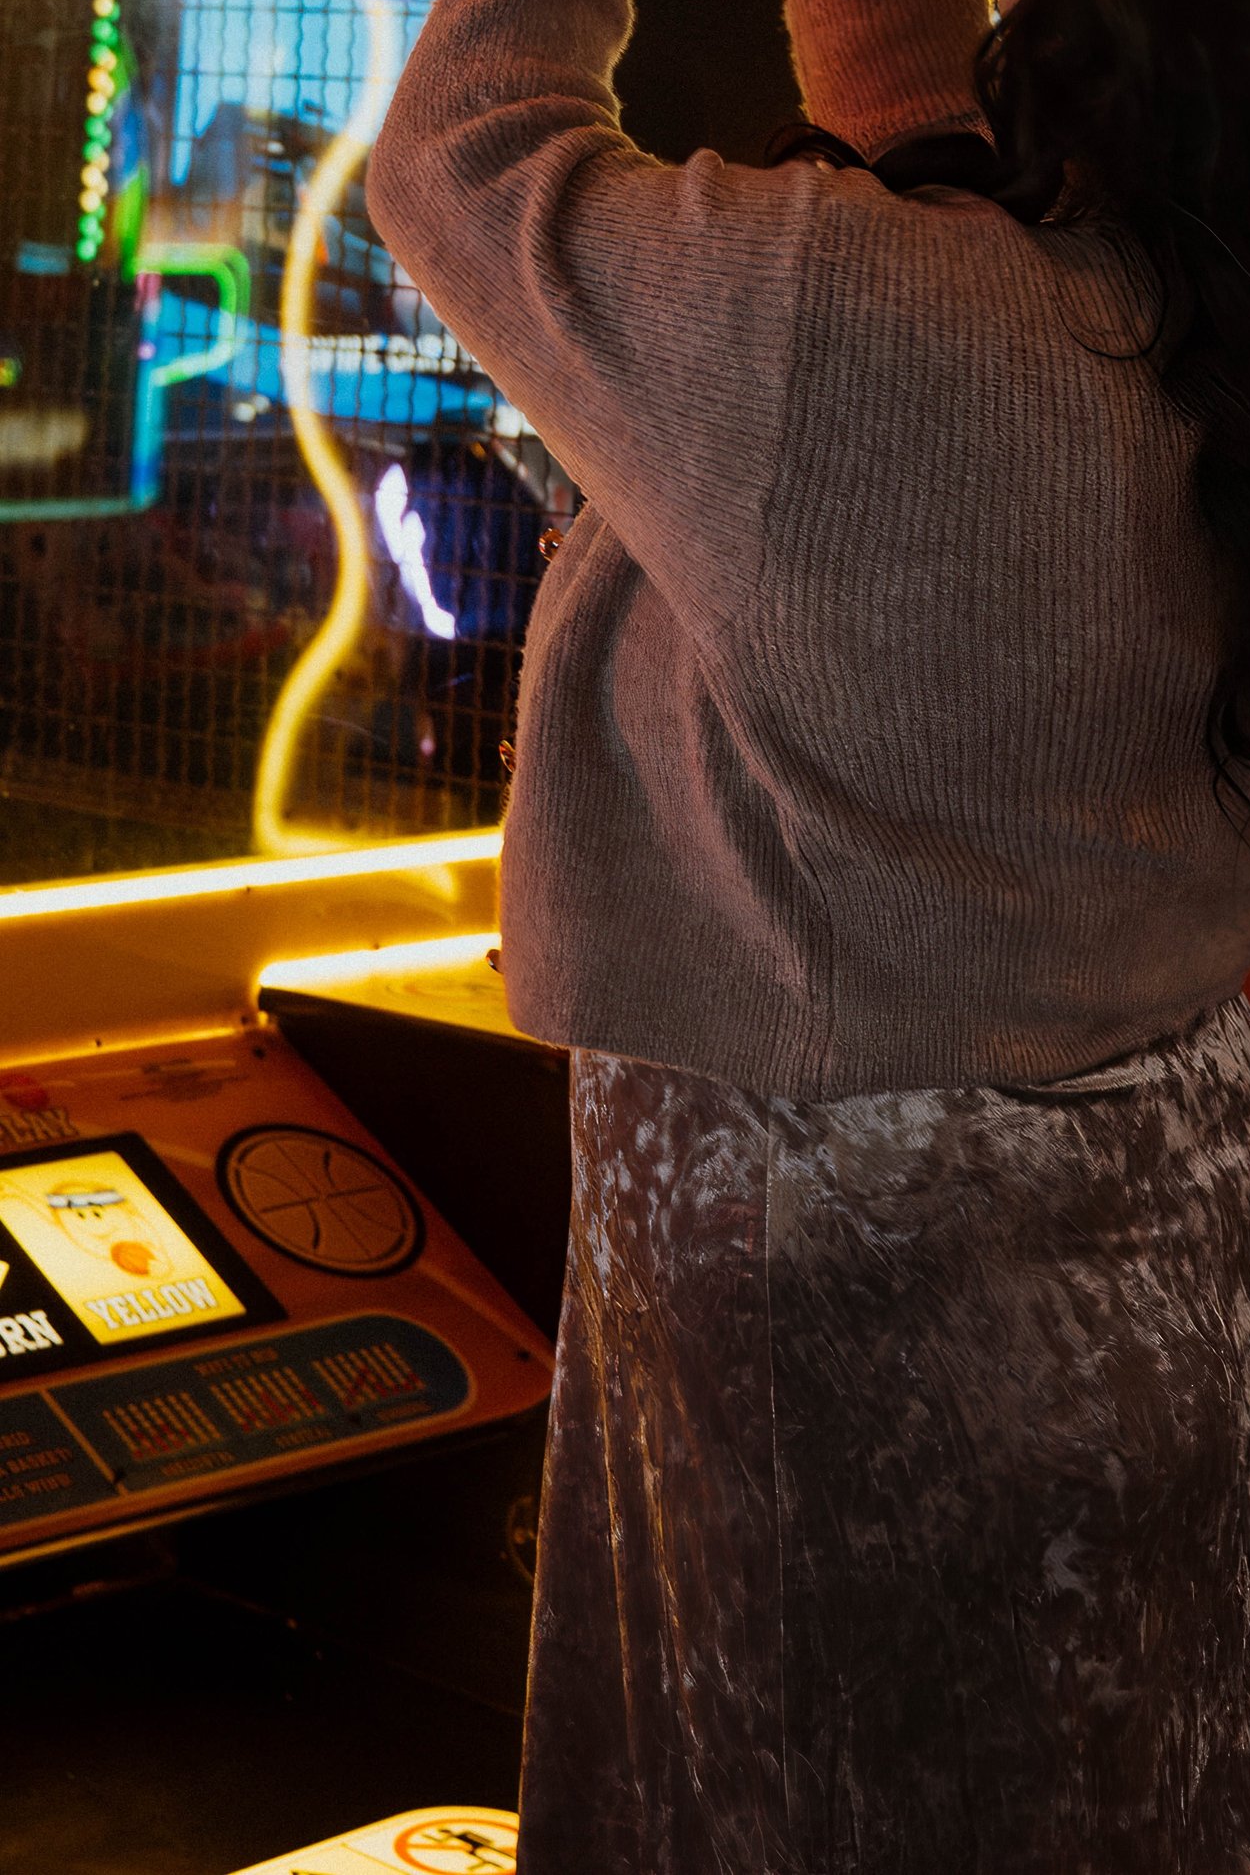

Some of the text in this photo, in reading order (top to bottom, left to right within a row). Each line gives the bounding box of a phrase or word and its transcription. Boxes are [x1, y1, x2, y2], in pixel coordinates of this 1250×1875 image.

[0, 1108, 79, 1145] LAY
[85, 1277, 218, 1331] YELLOW
[0, 1309, 65, 1358] RN
